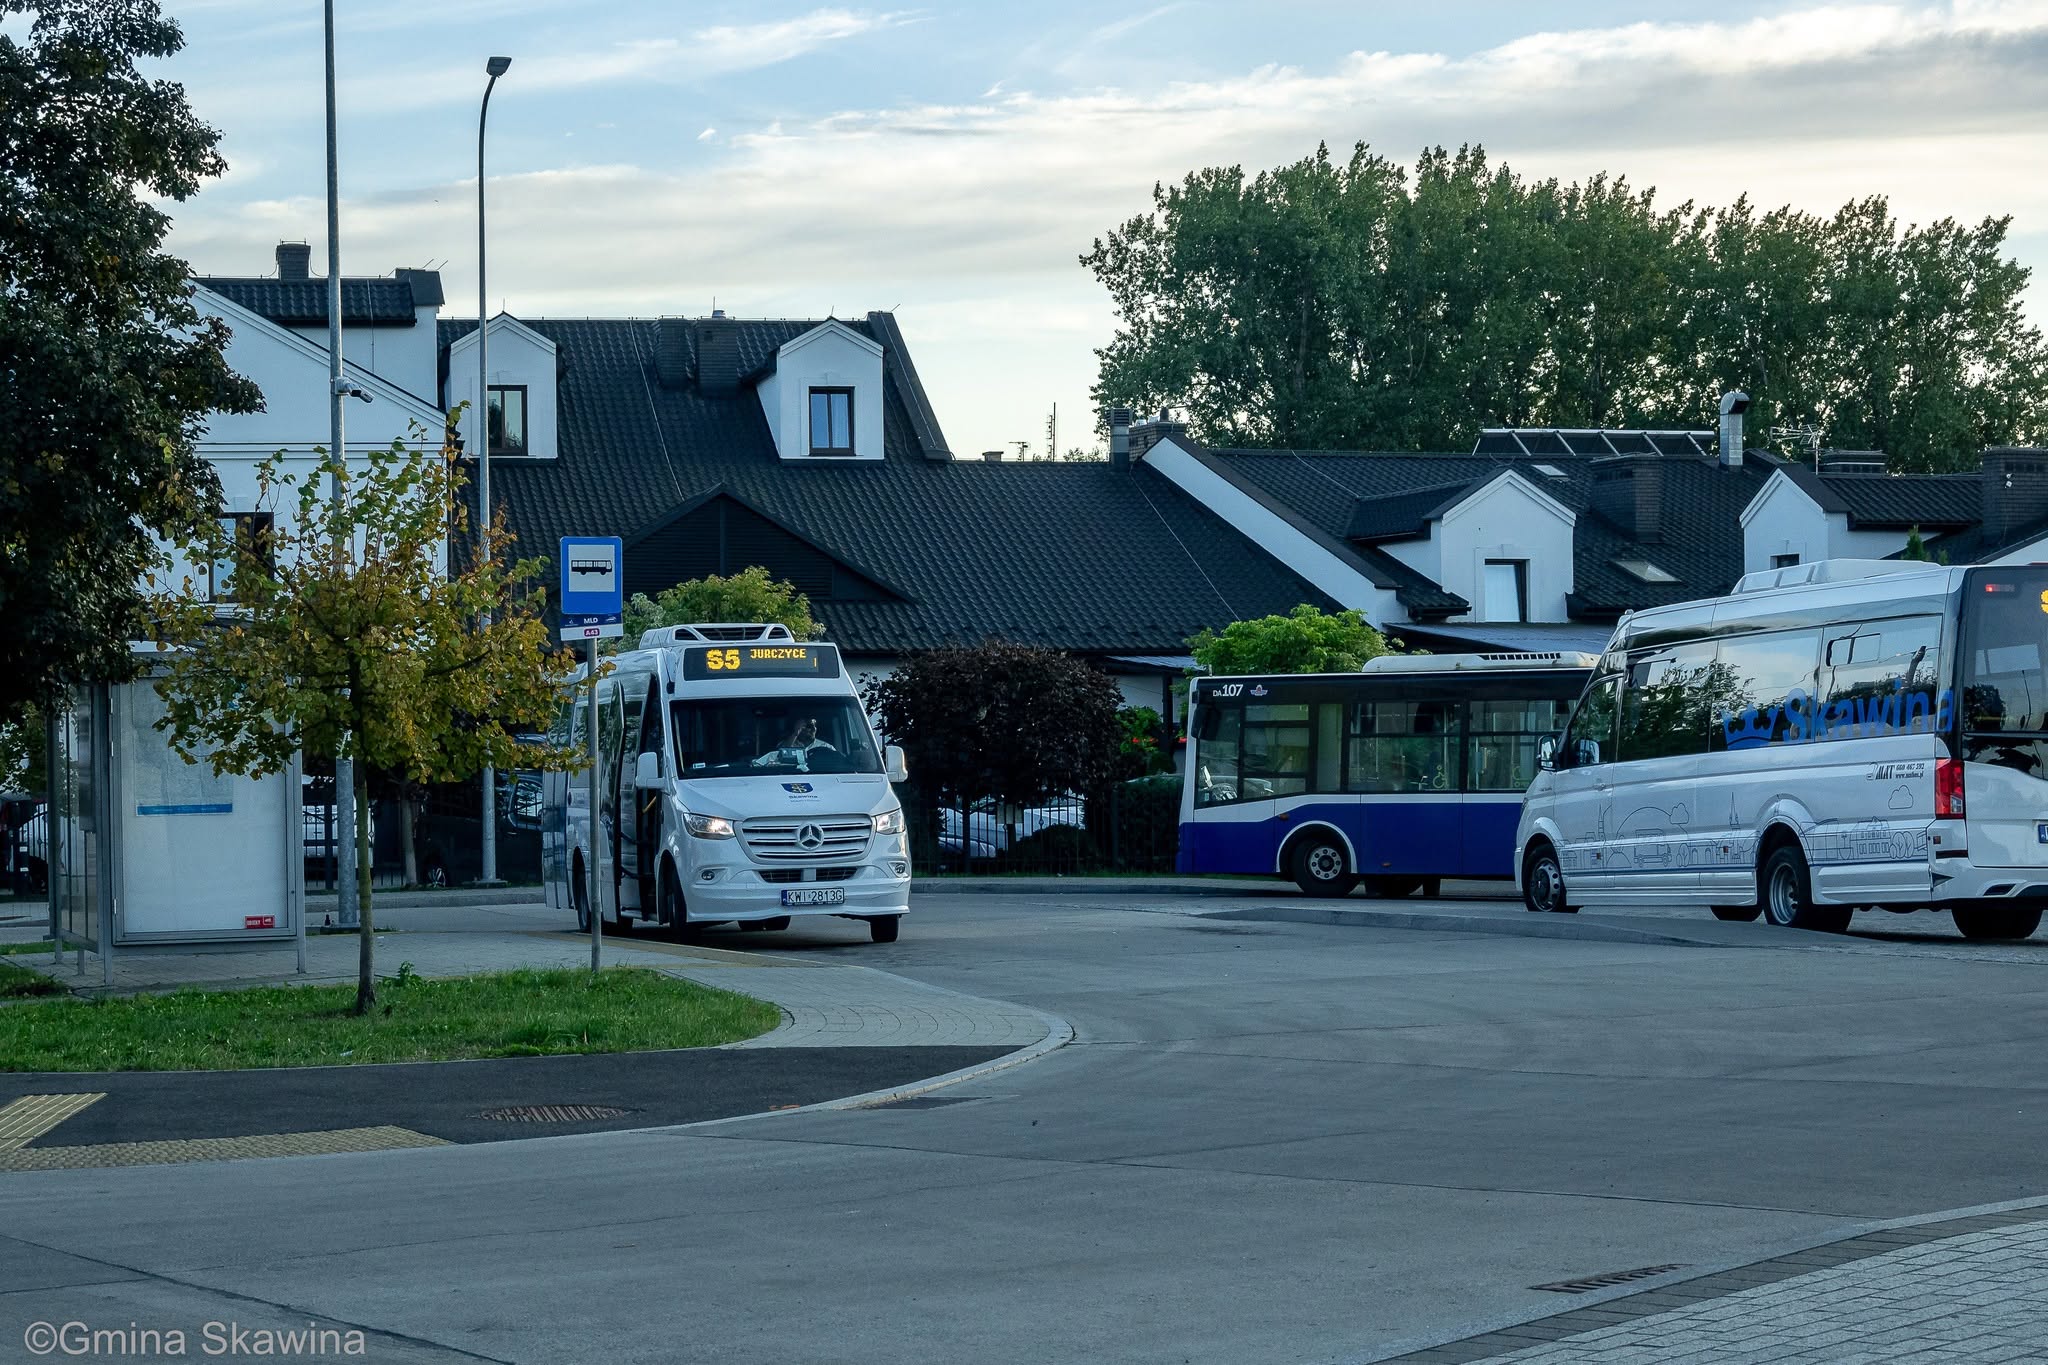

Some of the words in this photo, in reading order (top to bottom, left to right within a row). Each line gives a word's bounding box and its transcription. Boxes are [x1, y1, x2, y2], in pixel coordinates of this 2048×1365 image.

[583, 617, 599, 625] MLD
[706, 649, 740, 671] S5
[750, 648, 807, 659] JURCZYCE
[1782, 677, 1954, 744] Skawina
[788, 891, 806, 903] KWI
[811, 889, 843, 902] 2813G
